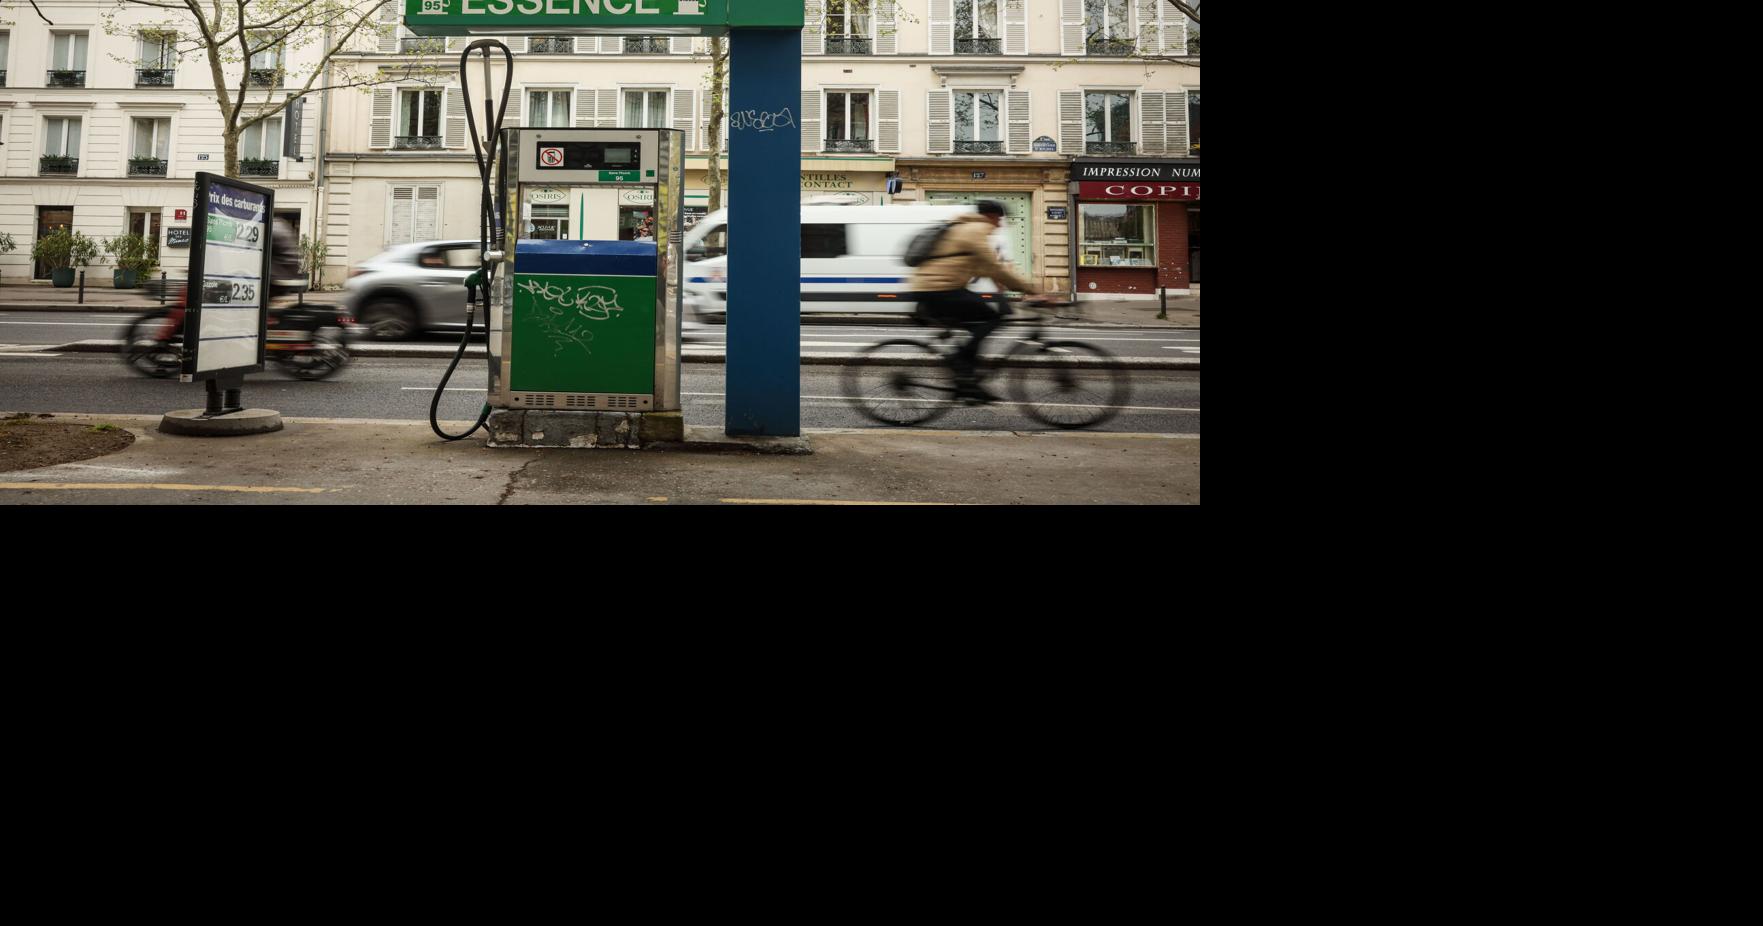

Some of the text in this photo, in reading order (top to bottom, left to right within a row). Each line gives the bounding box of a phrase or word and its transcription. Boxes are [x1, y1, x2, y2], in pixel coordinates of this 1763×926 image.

[424, 1, 441, 10] 95
[1083, 167, 1161, 177] IMPRESSION
[1105, 184, 1200, 199] COPI
[222, 194, 233, 207] des
